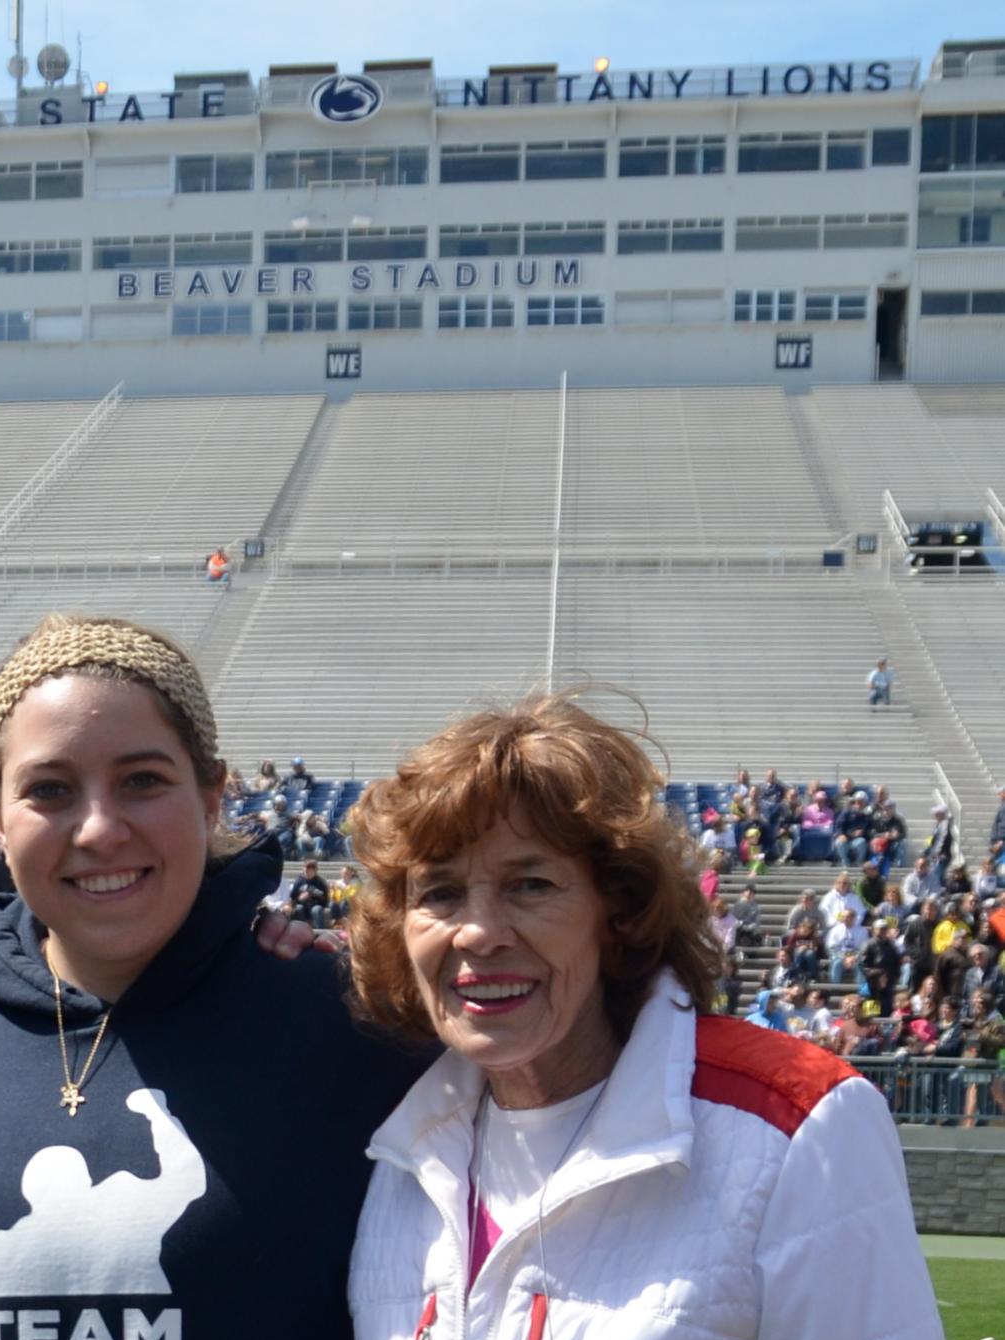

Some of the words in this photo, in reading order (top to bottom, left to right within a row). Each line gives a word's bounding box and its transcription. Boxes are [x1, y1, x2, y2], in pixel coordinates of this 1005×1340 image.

[463, 69, 692, 106] NITTANY
[726, 61, 892, 97] LIONS
[39, 90, 226, 125] STATE
[117, 266, 315, 298] BEAVER
[351, 259, 581, 290] STADIUM
[328, 353, 360, 376] WE
[778, 342, 811, 366] WF
